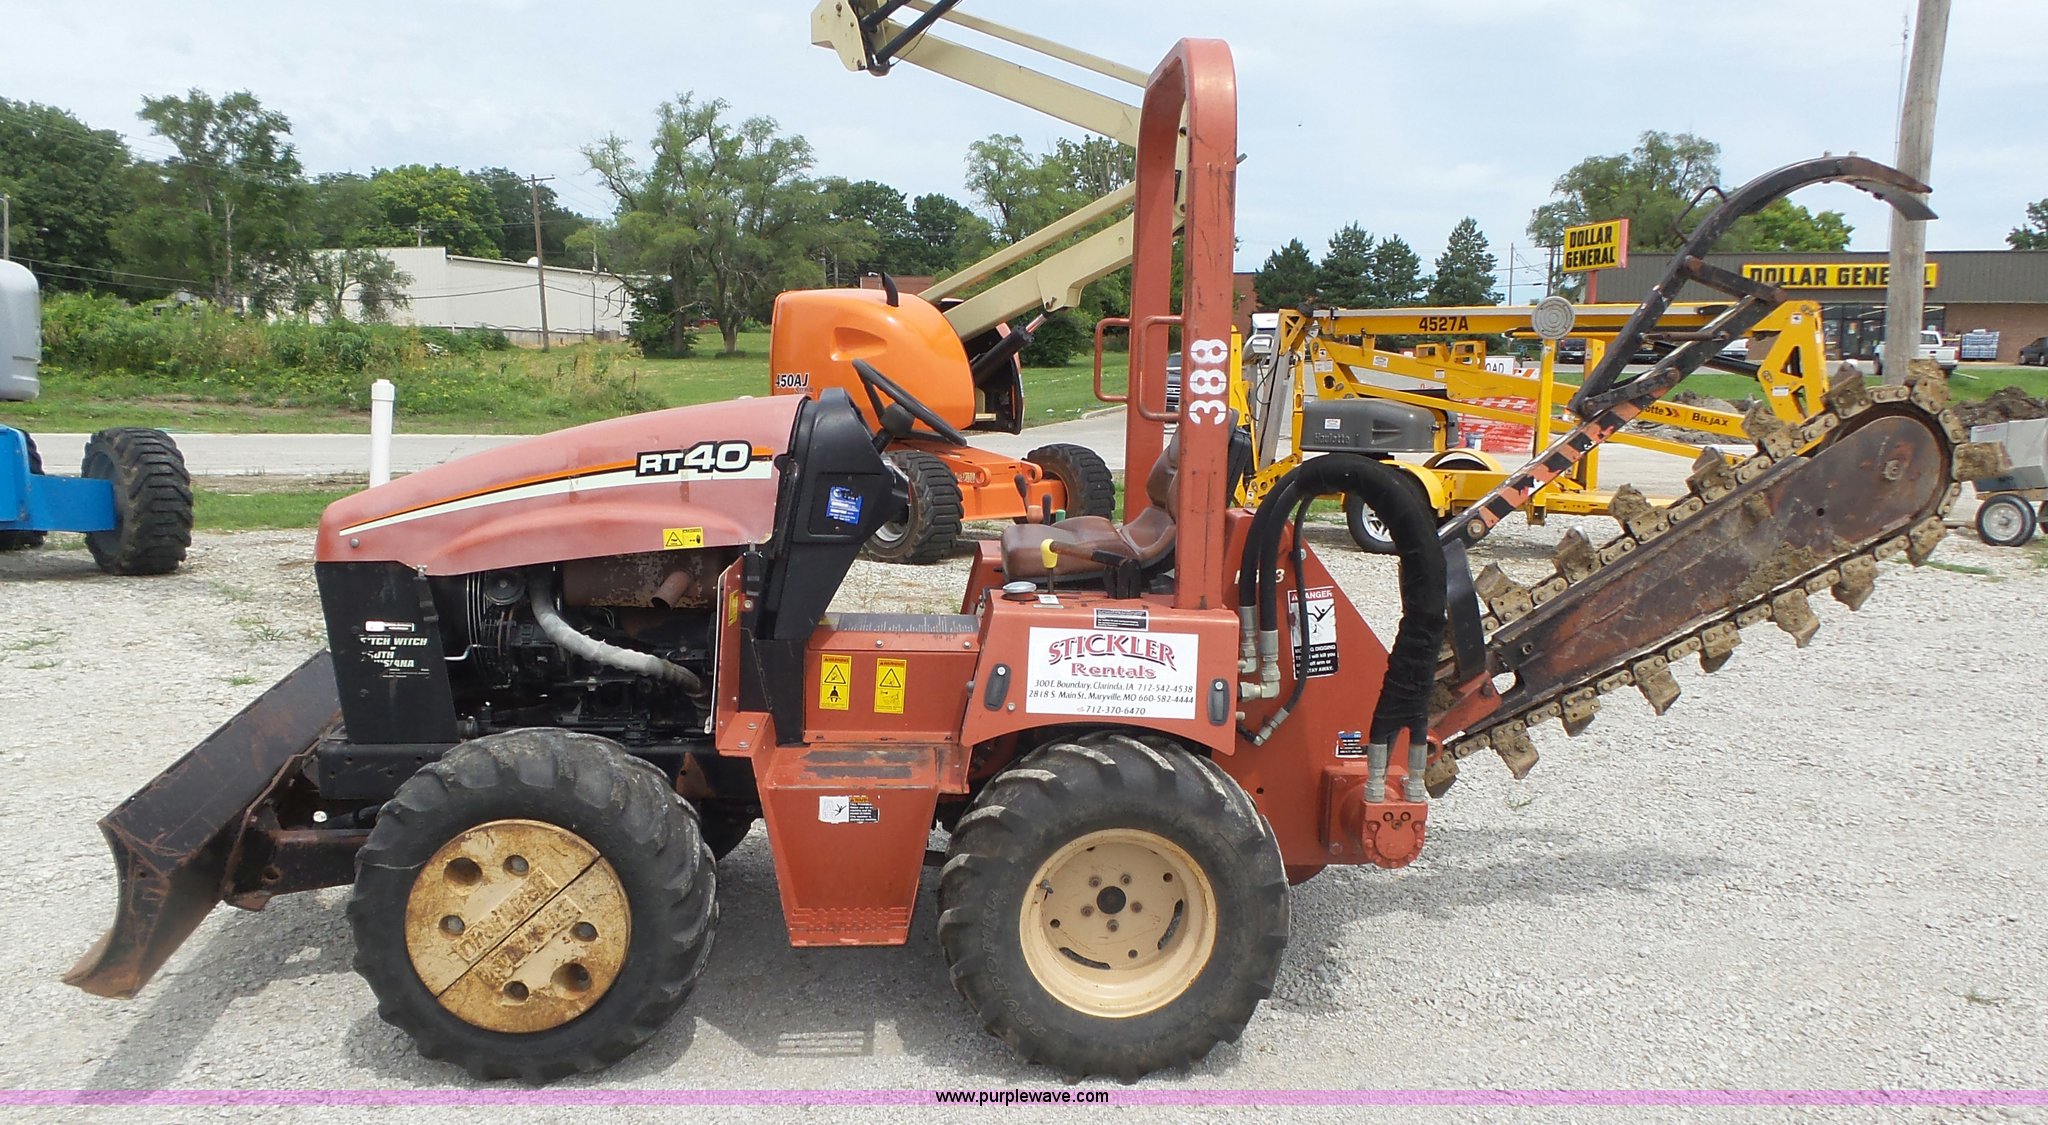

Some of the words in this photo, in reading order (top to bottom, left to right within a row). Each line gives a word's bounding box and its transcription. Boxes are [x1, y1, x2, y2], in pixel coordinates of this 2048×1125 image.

[1570, 226, 1612, 248] DOLLAR
[1566, 246, 1615, 268] GENERAL
[1750, 267, 1827, 286] DOLLAR
[1838, 266, 1930, 286] GENEL
[1419, 316, 1469, 332] 4527A
[1189, 339, 1228, 425] 388
[1692, 412, 1729, 427] BILJAX
[639, 443, 750, 475] RT40
[1305, 590, 1333, 600] ANGER
[394, 637, 428, 646] WITCH
[1048, 633, 1178, 672] STICKLER
[1071, 662, 1157, 680] Rentals
[1029, 690, 1049, 698] 2818
[1123, 694, 1137, 702] MO
[1138, 695, 1194, 704] 660-582-4444
[1137, 684, 1193, 694] 712-542-4538
[1086, 705, 1146, 715] 712-370-6470
